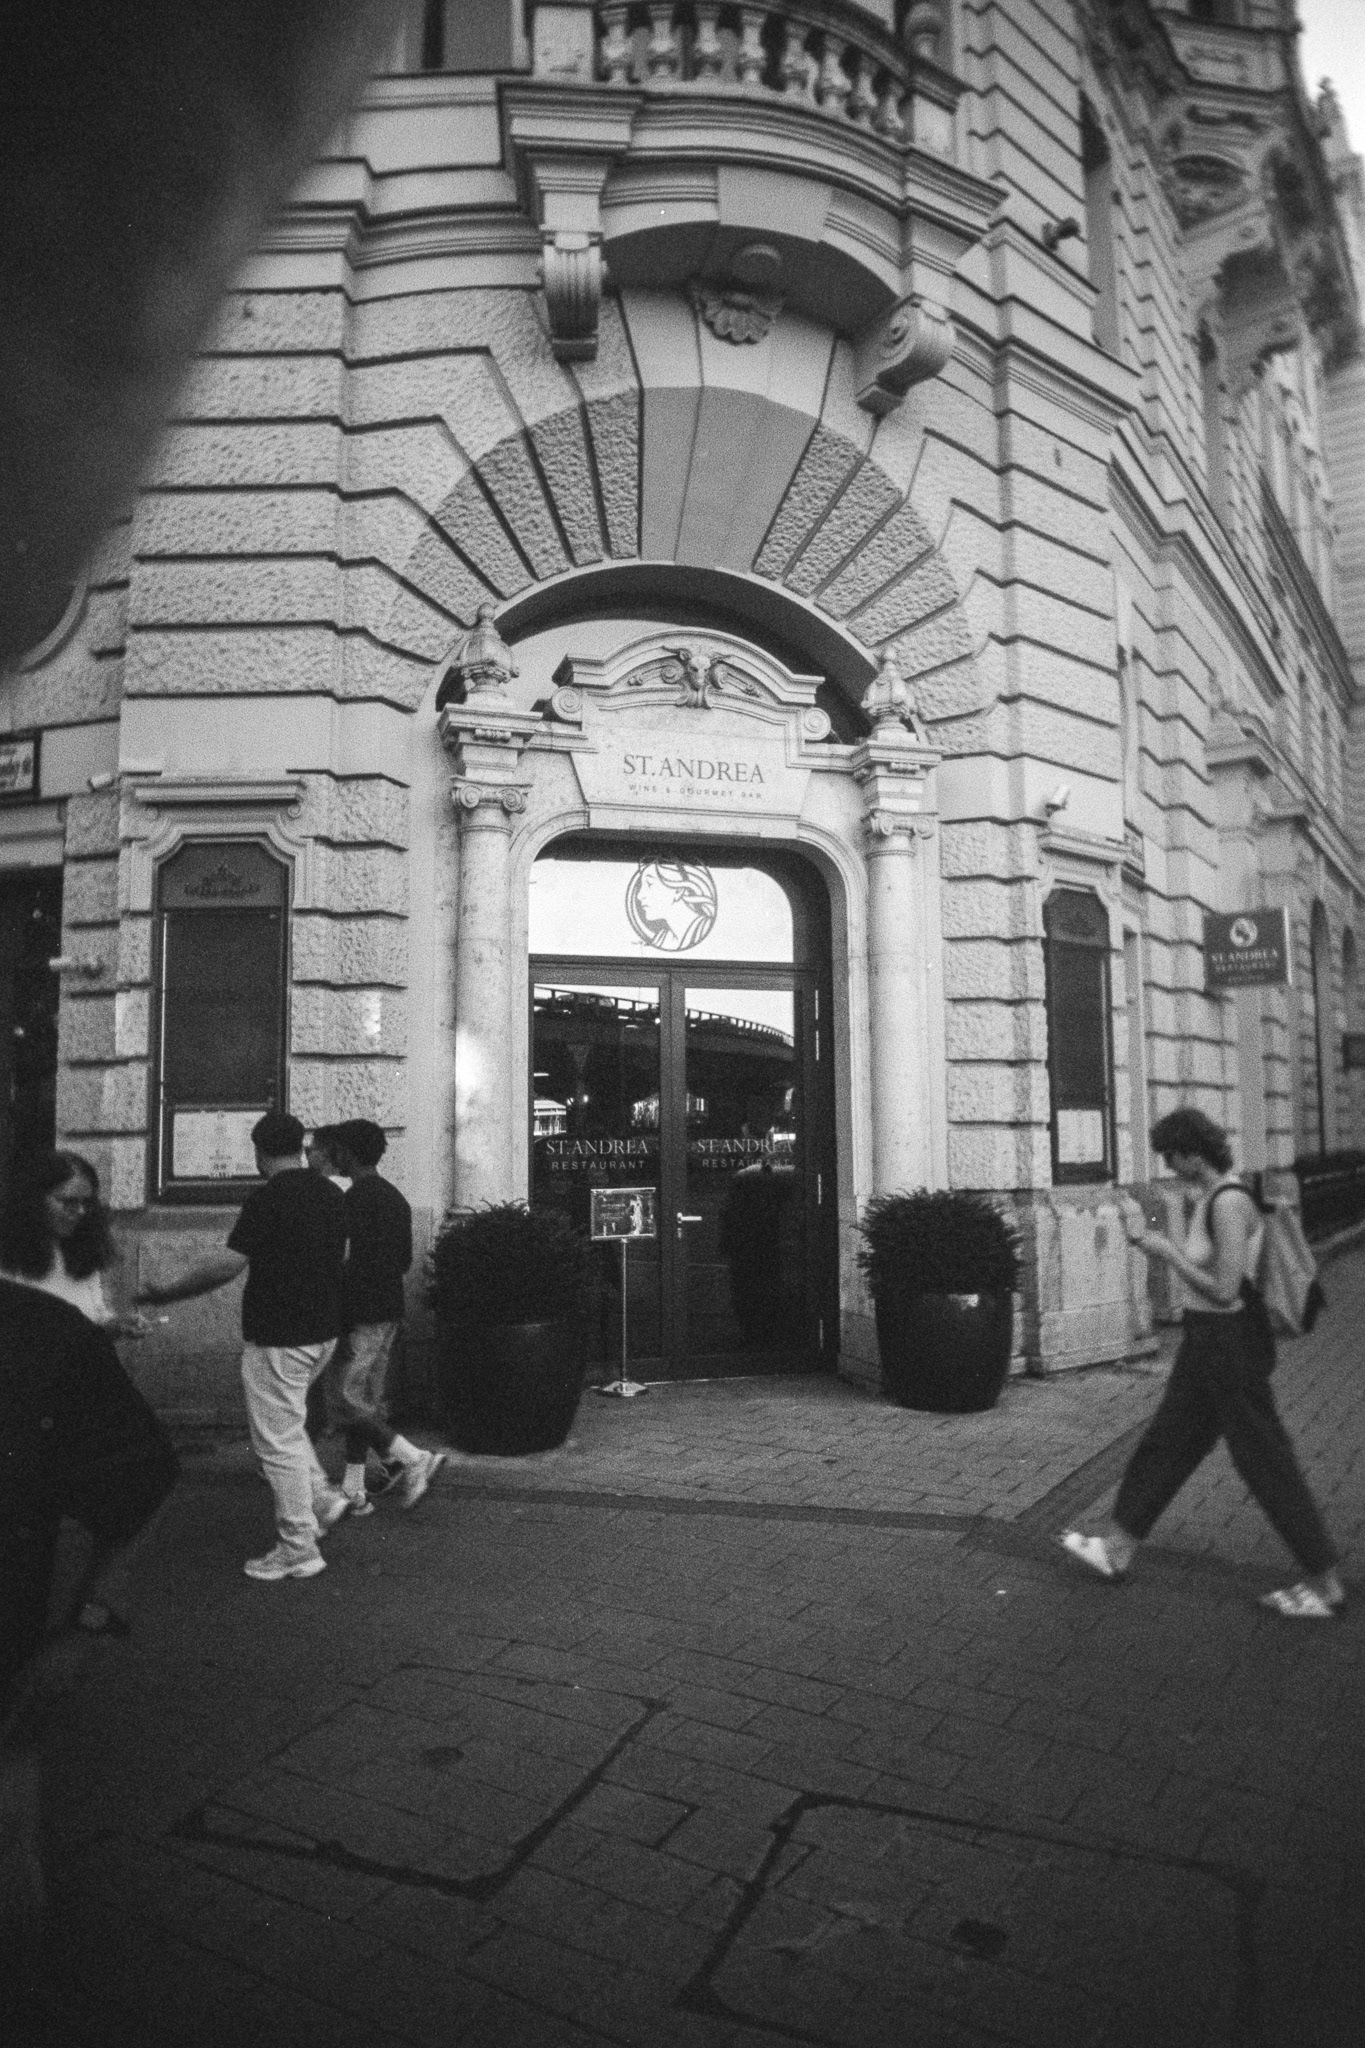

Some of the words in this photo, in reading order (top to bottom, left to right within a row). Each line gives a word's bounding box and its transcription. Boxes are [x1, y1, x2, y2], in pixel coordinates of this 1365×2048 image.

[623, 753, 766, 784] ST.ANDREA
[629, 784, 658, 793] WINE
[680, 786, 734, 798] GOURMET
[741, 791, 763, 799] BAR
[546, 1139, 649, 1156] ST.ANDREA
[697, 1138, 793, 1154] ST.ANDREA
[551, 1160, 645, 1171] RESTAURANT
